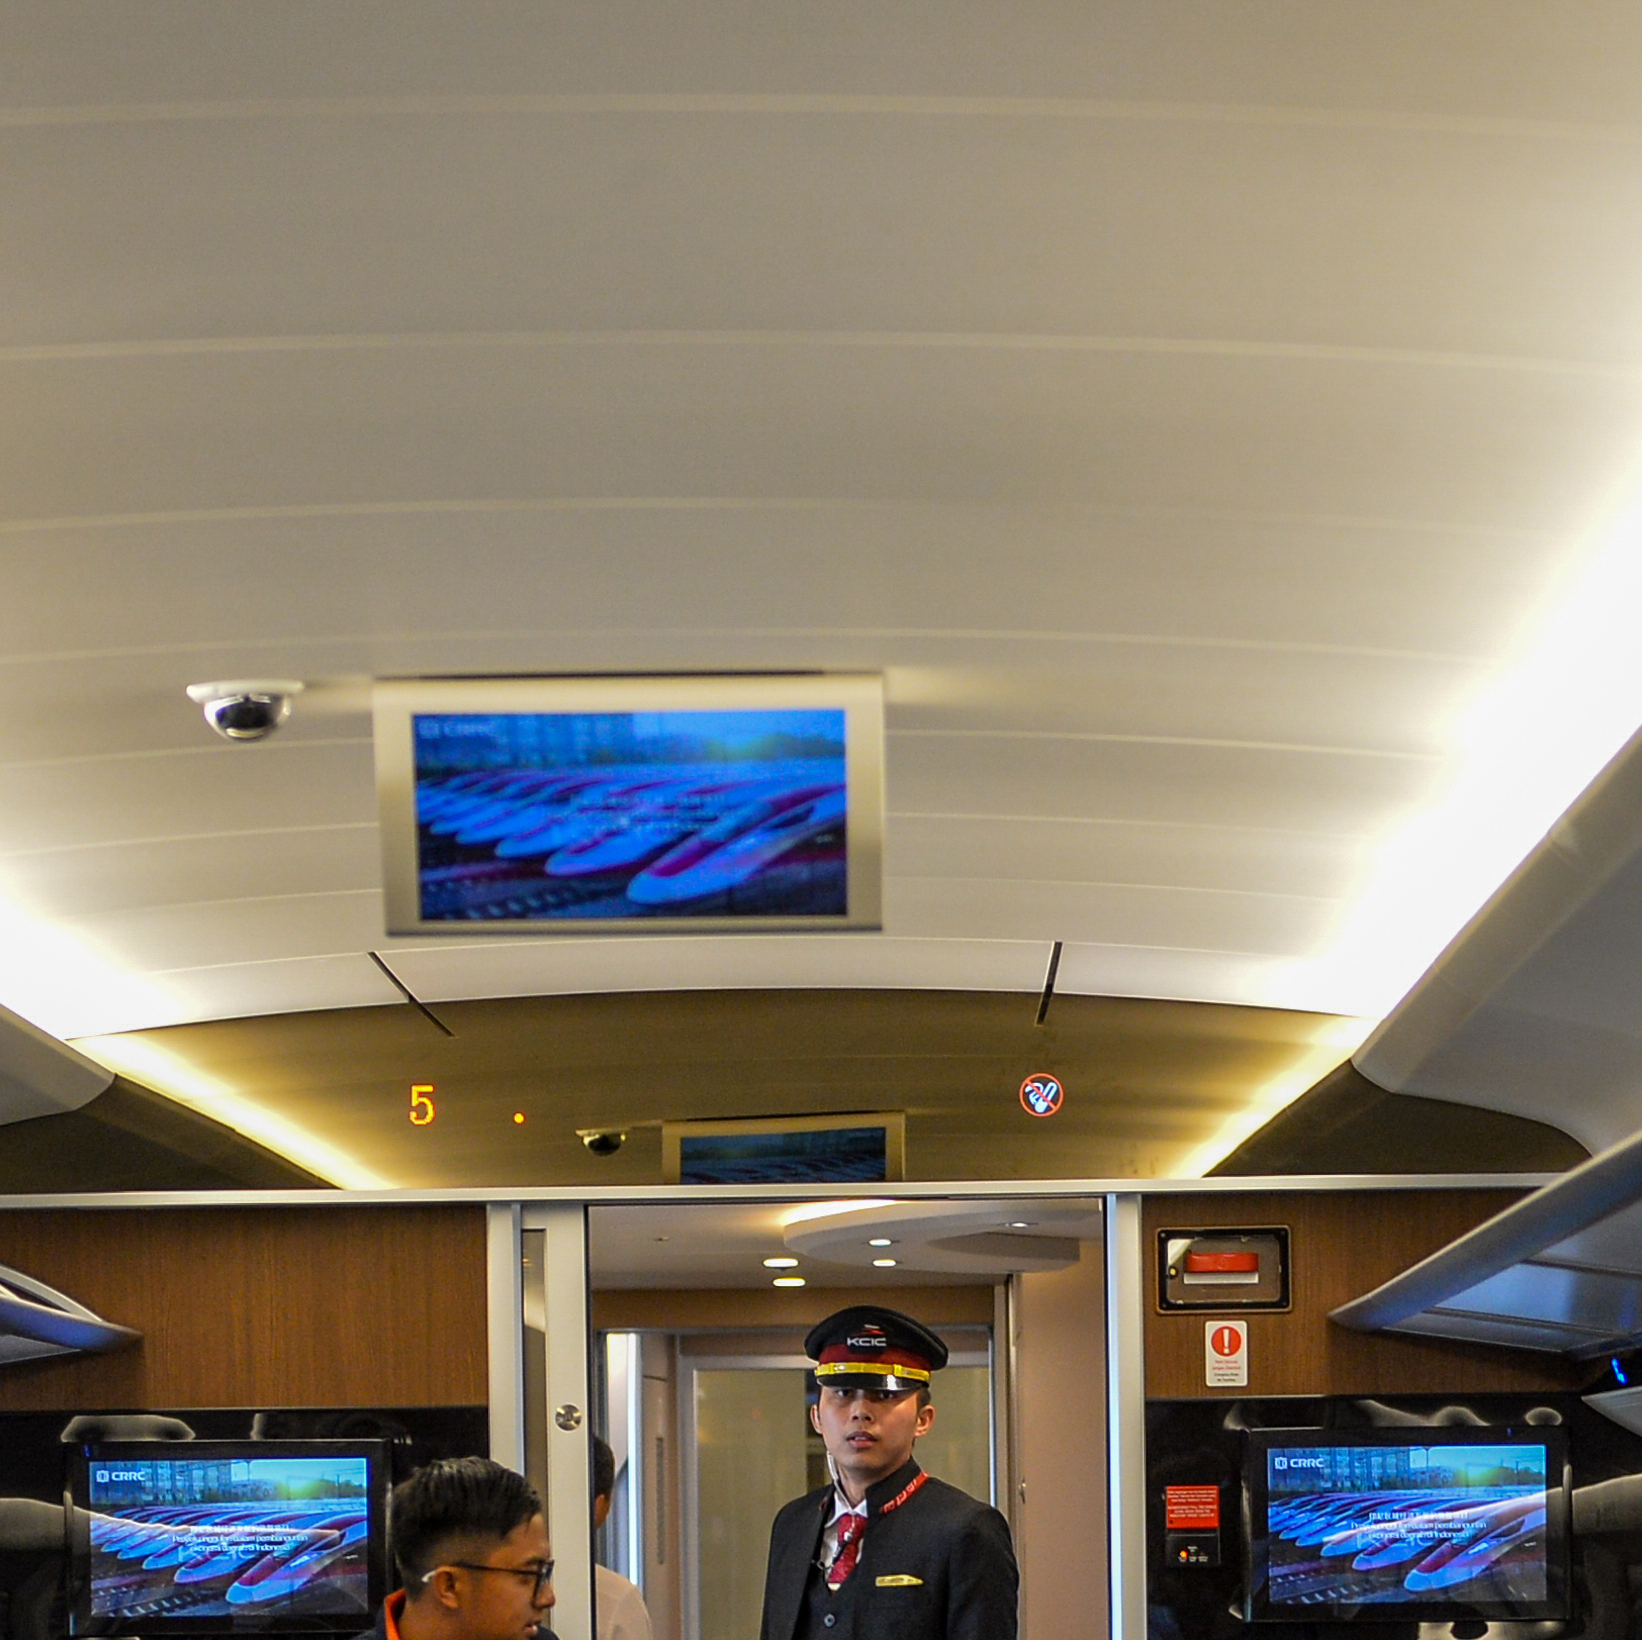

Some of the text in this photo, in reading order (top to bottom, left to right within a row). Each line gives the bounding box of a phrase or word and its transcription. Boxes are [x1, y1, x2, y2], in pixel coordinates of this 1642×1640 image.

[409, 1084, 435, 1126] 5
[846, 1337, 887, 1347] KCIC
[1289, 1458, 1324, 1468] CRRC
[111, 1471, 146, 1481] CRRC
